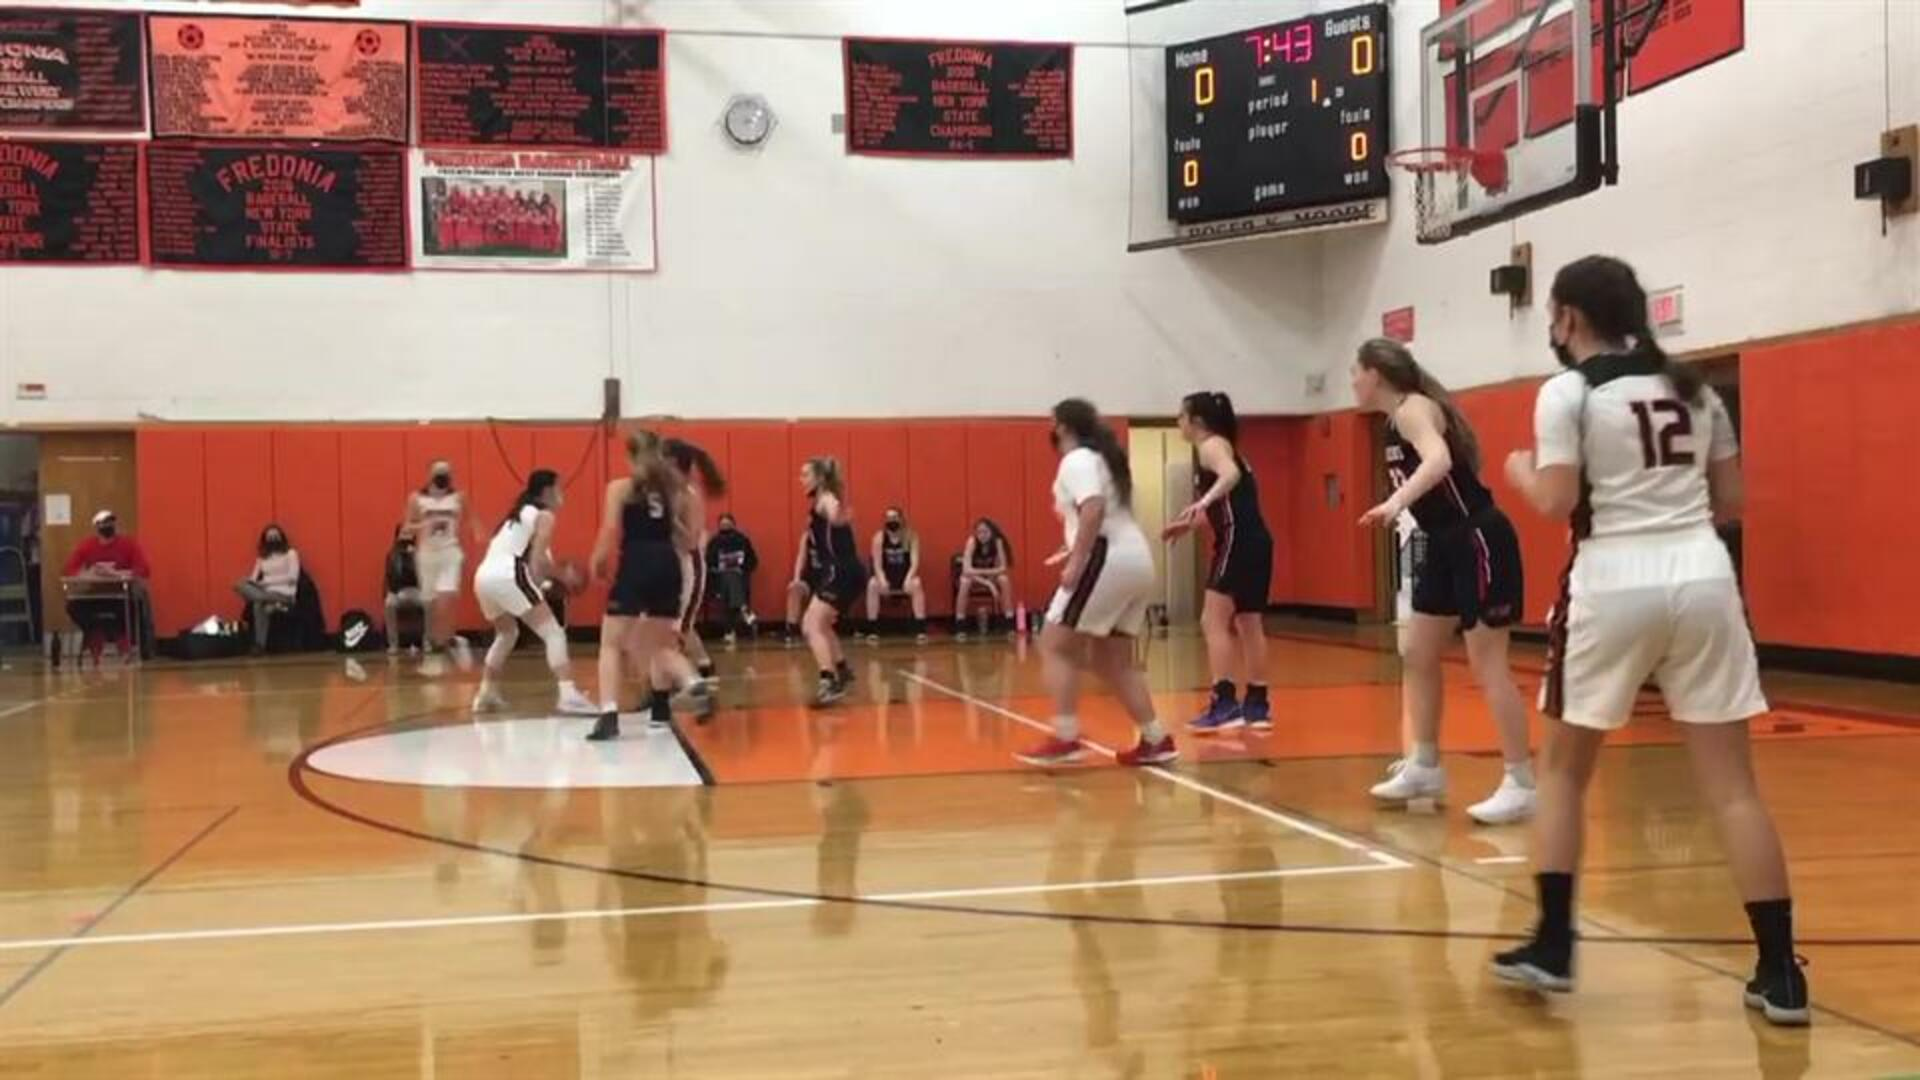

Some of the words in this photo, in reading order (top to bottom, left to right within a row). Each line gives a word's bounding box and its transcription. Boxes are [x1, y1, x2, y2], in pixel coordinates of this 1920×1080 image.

[1325, 15, 1371, 37] Guests
[1175, 49, 1208, 68] Home
[1246, 24, 1313, 67] 7:43
[1352, 35, 1373, 75] 0
[1195, 67, 1214, 105] 0
[1248, 92, 1289, 115] period
[1248, 121, 1289, 141] player
[1351, 132, 1367, 161] 0
[215, 153, 337, 193] FREDONIA
[1184, 160, 1198, 187] 0
[1254, 183, 1285, 202] game
[1629, 399, 1696, 469] 12
